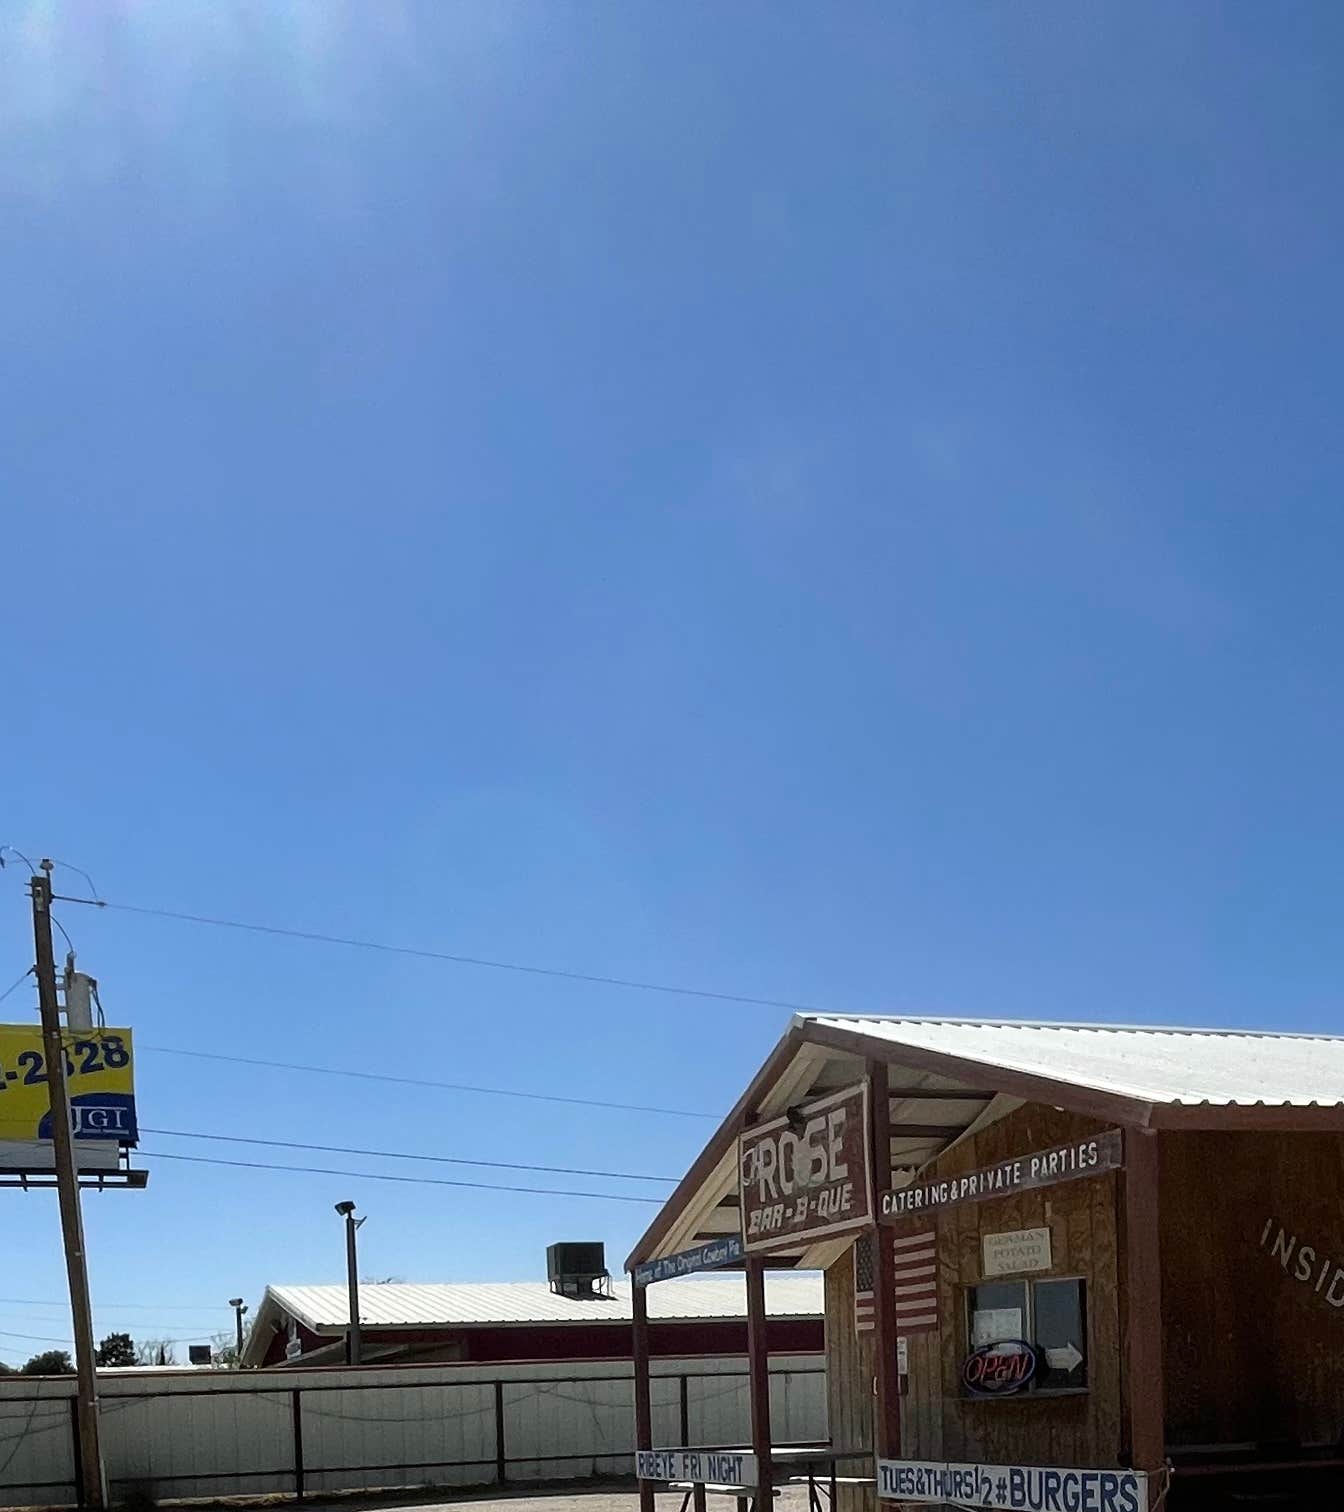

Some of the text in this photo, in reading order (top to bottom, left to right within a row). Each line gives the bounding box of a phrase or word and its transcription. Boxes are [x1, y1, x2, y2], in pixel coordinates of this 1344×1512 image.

[71, 1106, 123, 1134] JGI
[758, 1107, 850, 1203] ROSE
[1031, 1142, 1099, 1178] PARTIES
[966, 1353, 1030, 1383] OPEN
[638, 1453, 743, 1482] RIBEYE FRI NIGHT
